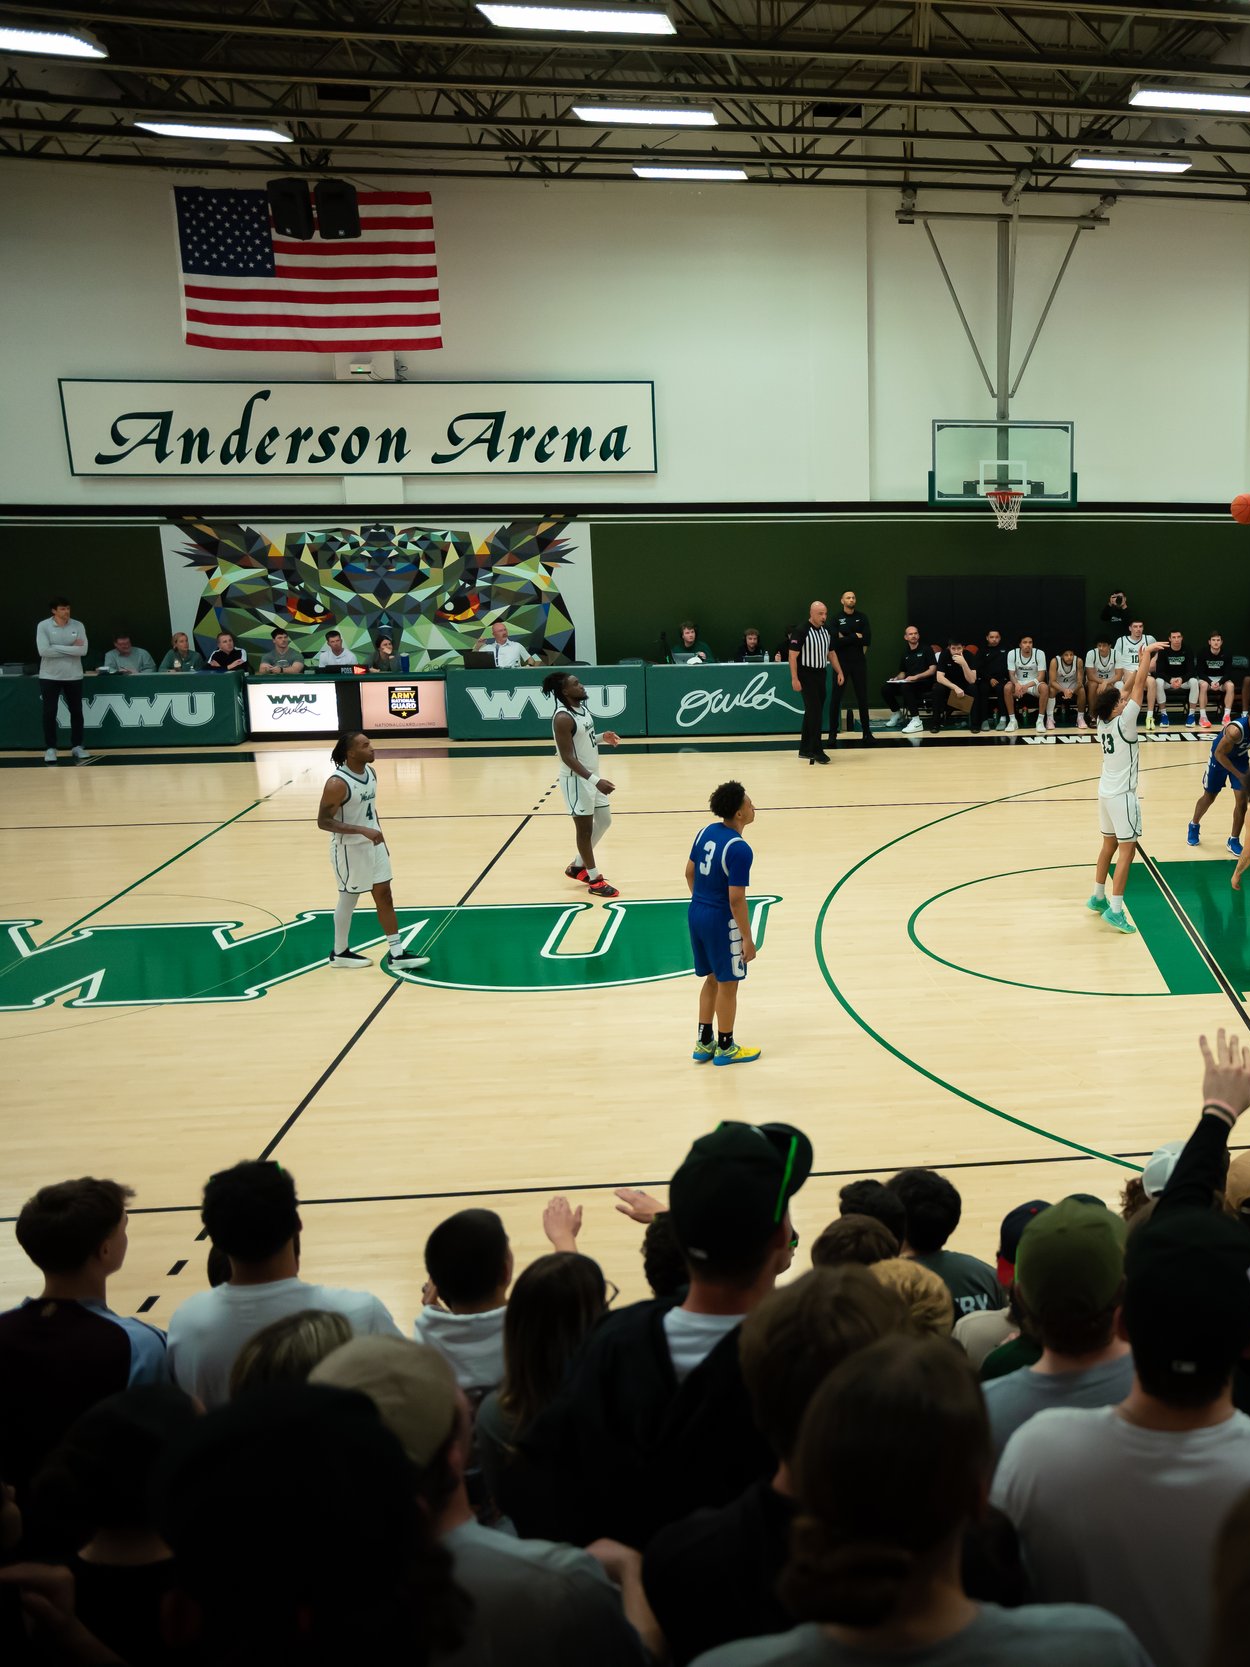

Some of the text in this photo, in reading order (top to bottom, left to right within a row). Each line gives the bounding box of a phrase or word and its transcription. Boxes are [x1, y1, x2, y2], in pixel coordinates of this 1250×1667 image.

[95, 390, 631, 466] Anderson Arena
[267, 694, 317, 704] WWU
[1101, 733, 1115, 754] 13
[365, 802, 374, 820] 4
[700, 840, 717, 876] 3
